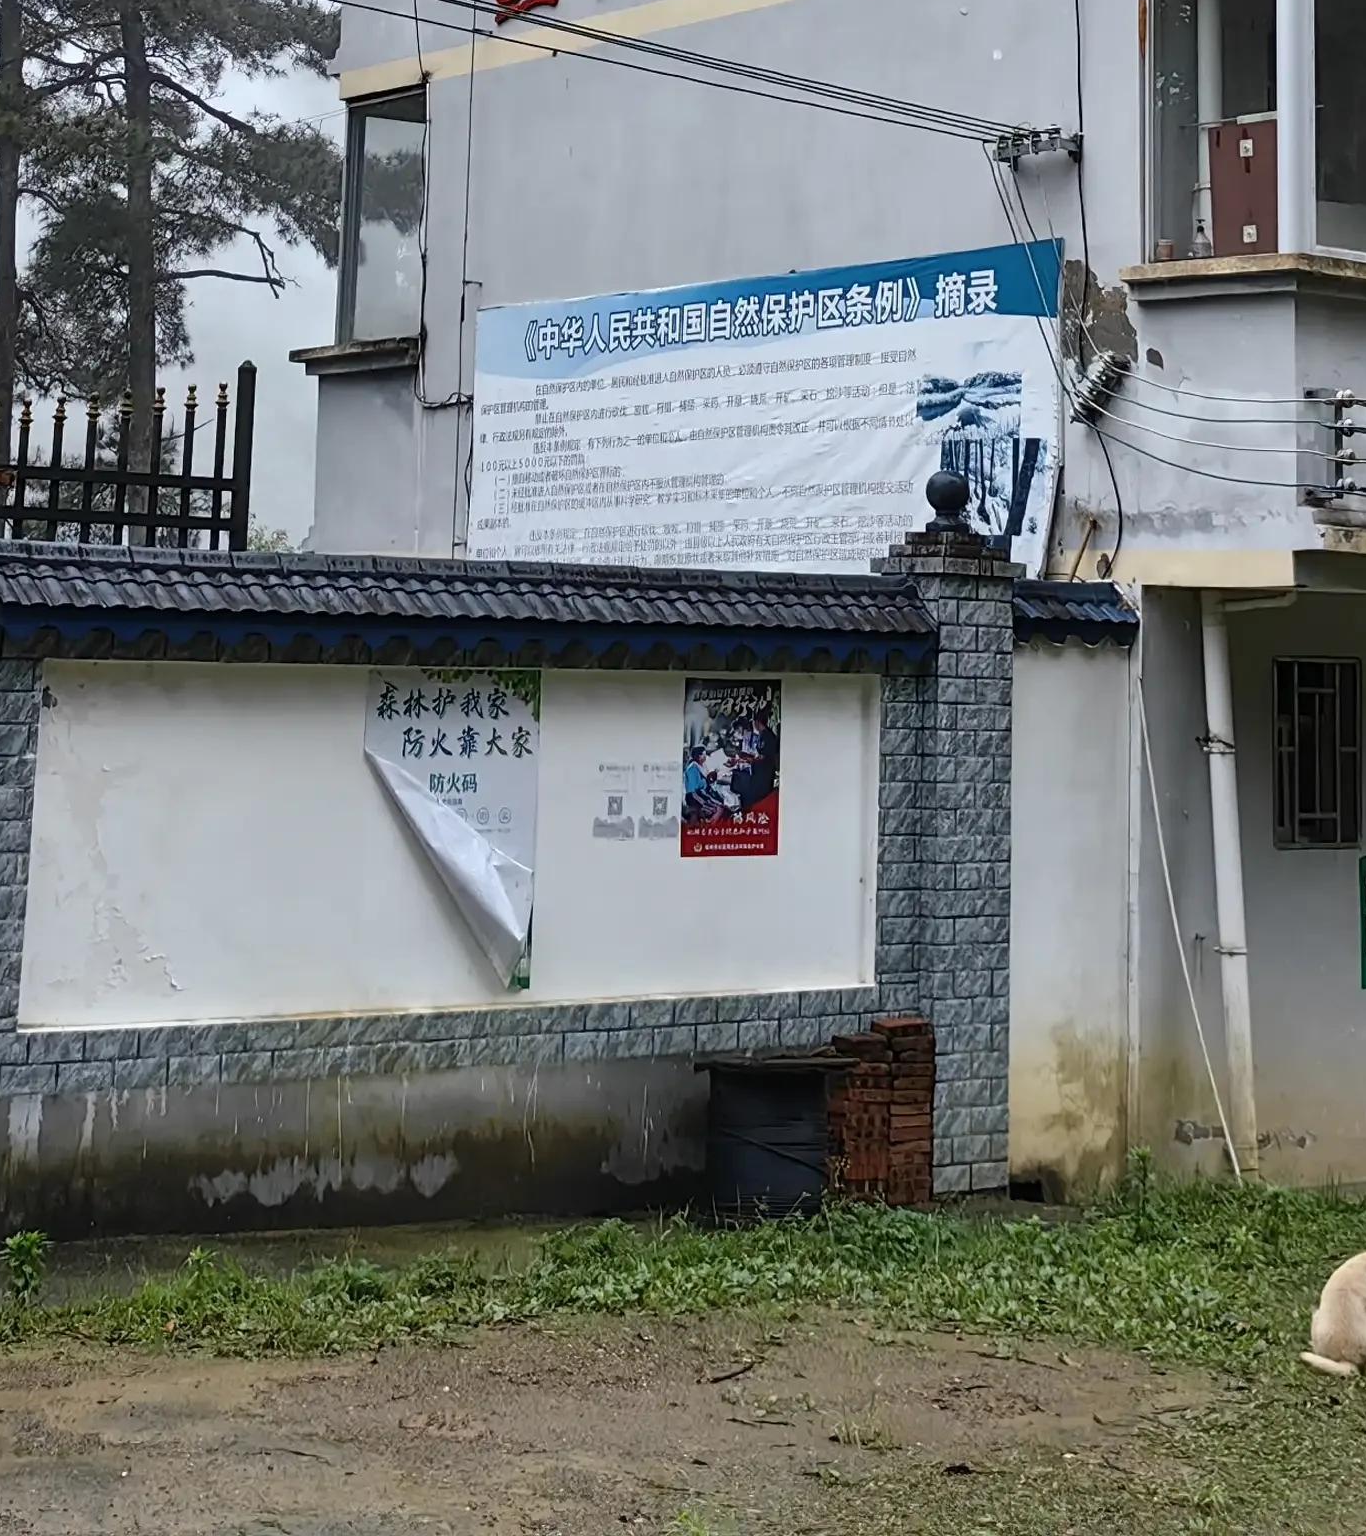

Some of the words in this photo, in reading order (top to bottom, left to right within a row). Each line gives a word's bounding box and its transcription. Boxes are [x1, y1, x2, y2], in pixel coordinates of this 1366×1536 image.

[377, 685, 510, 721] 森林护我家
[401, 725, 534, 760] 防火靠大家
[429, 772, 478, 794] 防火码
